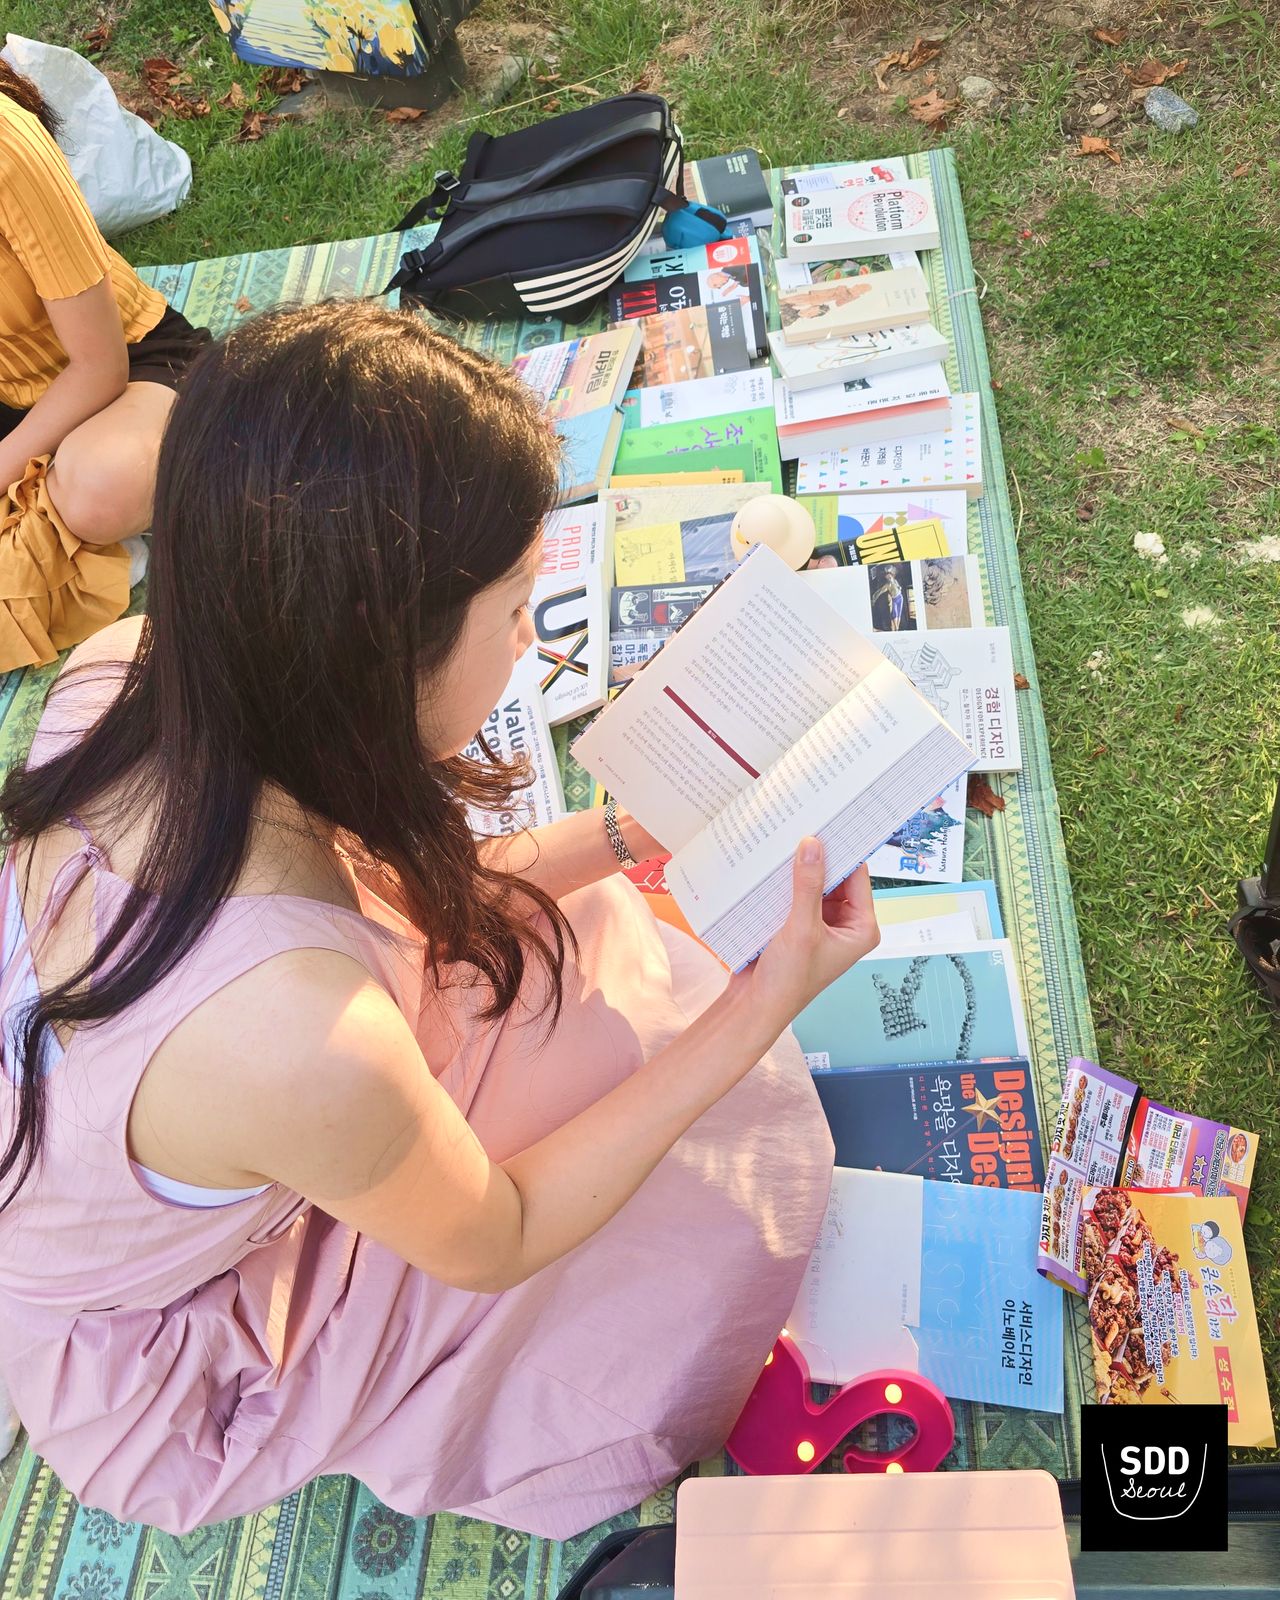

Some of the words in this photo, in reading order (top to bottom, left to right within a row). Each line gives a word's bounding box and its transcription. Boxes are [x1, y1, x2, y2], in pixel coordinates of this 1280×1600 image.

[872, 193, 889, 232] Revolution
[887, 191, 904, 230] Platform
[586, 350, 611, 394] 마케팅
[876, 447, 886, 465] 지역을
[893, 445, 903, 471] 디자인이
[534, 584, 589, 695] UX
[612, 644, 623, 668] 참가
[975, 687, 983, 710] DESIGN
[985, 687, 1000, 713] 경험
[977, 723, 986, 760] EXPERIENCE
[988, 718, 1005, 760] 디자인
[938, 847, 949, 873] Katsura
[992, 951, 1003, 966] UX
[960, 1072, 977, 1099] the
[931, 1074, 956, 1134] 욕망을
[1099, 1099, 1111, 1128] 주류메뉴
[993, 1069, 1041, 1193] Designi
[967, 1131, 1002, 1188] Des
[1042, 1213, 1050, 1222] 맛
[1039, 1224, 1050, 1253] 4가지
[1162, 1271, 1171, 1284] 모든
[1180, 1270, 1189, 1301] 안녕하세요
[1165, 1286, 1173, 1305] 정성과
[1144, 1242, 1153, 1274] 고객님께서
[1154, 1349, 1164, 1384] 감사합니다.
[1166, 1307, 1175, 1326] 열정을
[1184, 1304, 1194, 1336] 큰손닭강정
[1001, 1299, 1016, 1369] 이노베이션
[1017, 1300, 1034, 1386] 서비스디자인
[1190, 1338, 1198, 1359] 입니다.
